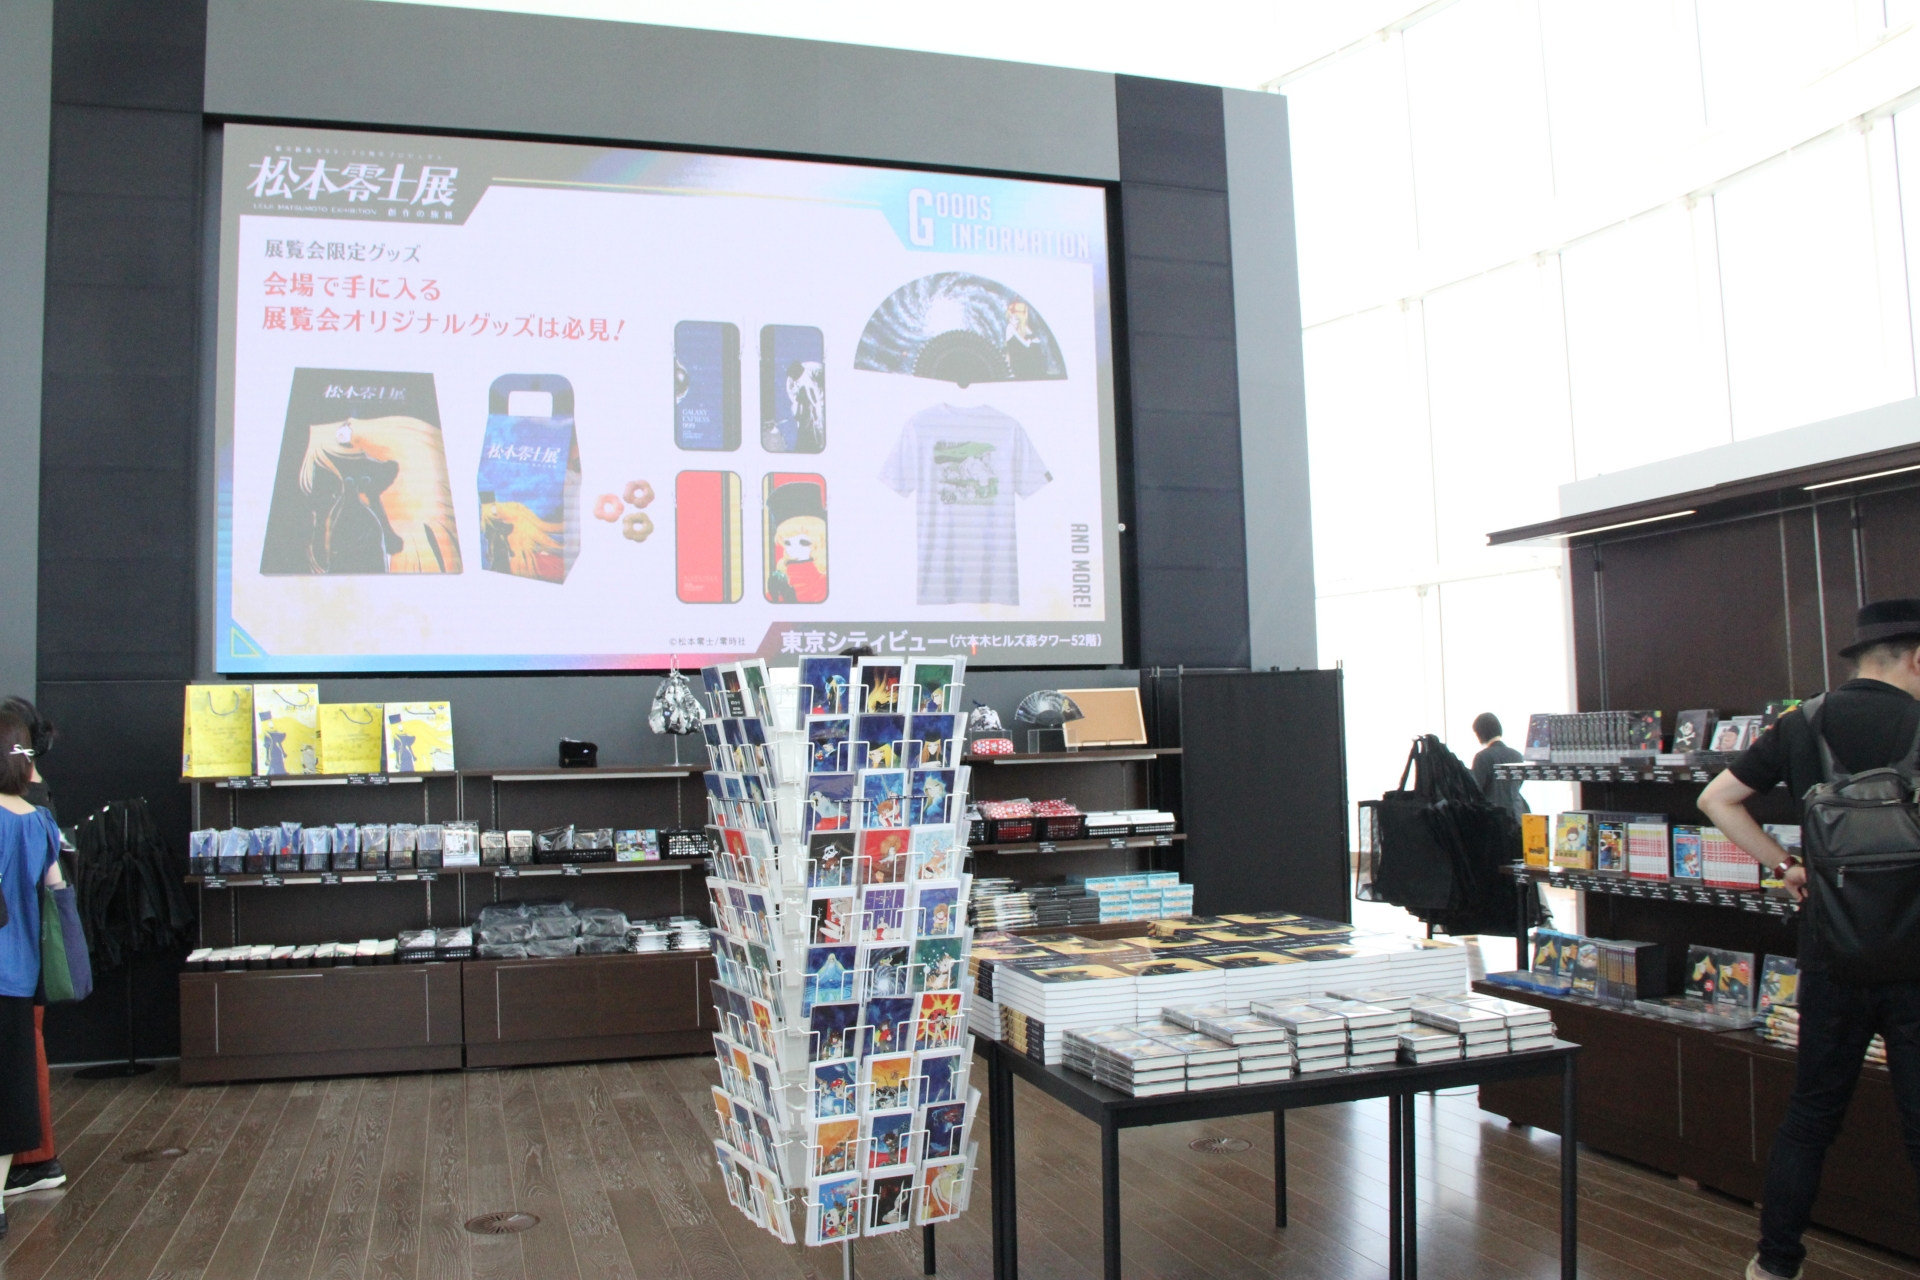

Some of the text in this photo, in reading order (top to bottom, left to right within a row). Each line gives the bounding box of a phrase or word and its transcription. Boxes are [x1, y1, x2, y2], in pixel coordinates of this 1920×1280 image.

[247, 155, 458, 207] 松本零士展
[277, 203, 328, 213] MATSUMOTO
[908, 187, 992, 247] GOODS
[264, 238, 421, 264] 展覧会限定グッズ
[953, 223, 1089, 258] INFORMATION
[262, 271, 441, 301] 会場で手に入る
[1070, 523, 1091, 608] AND MORE!
